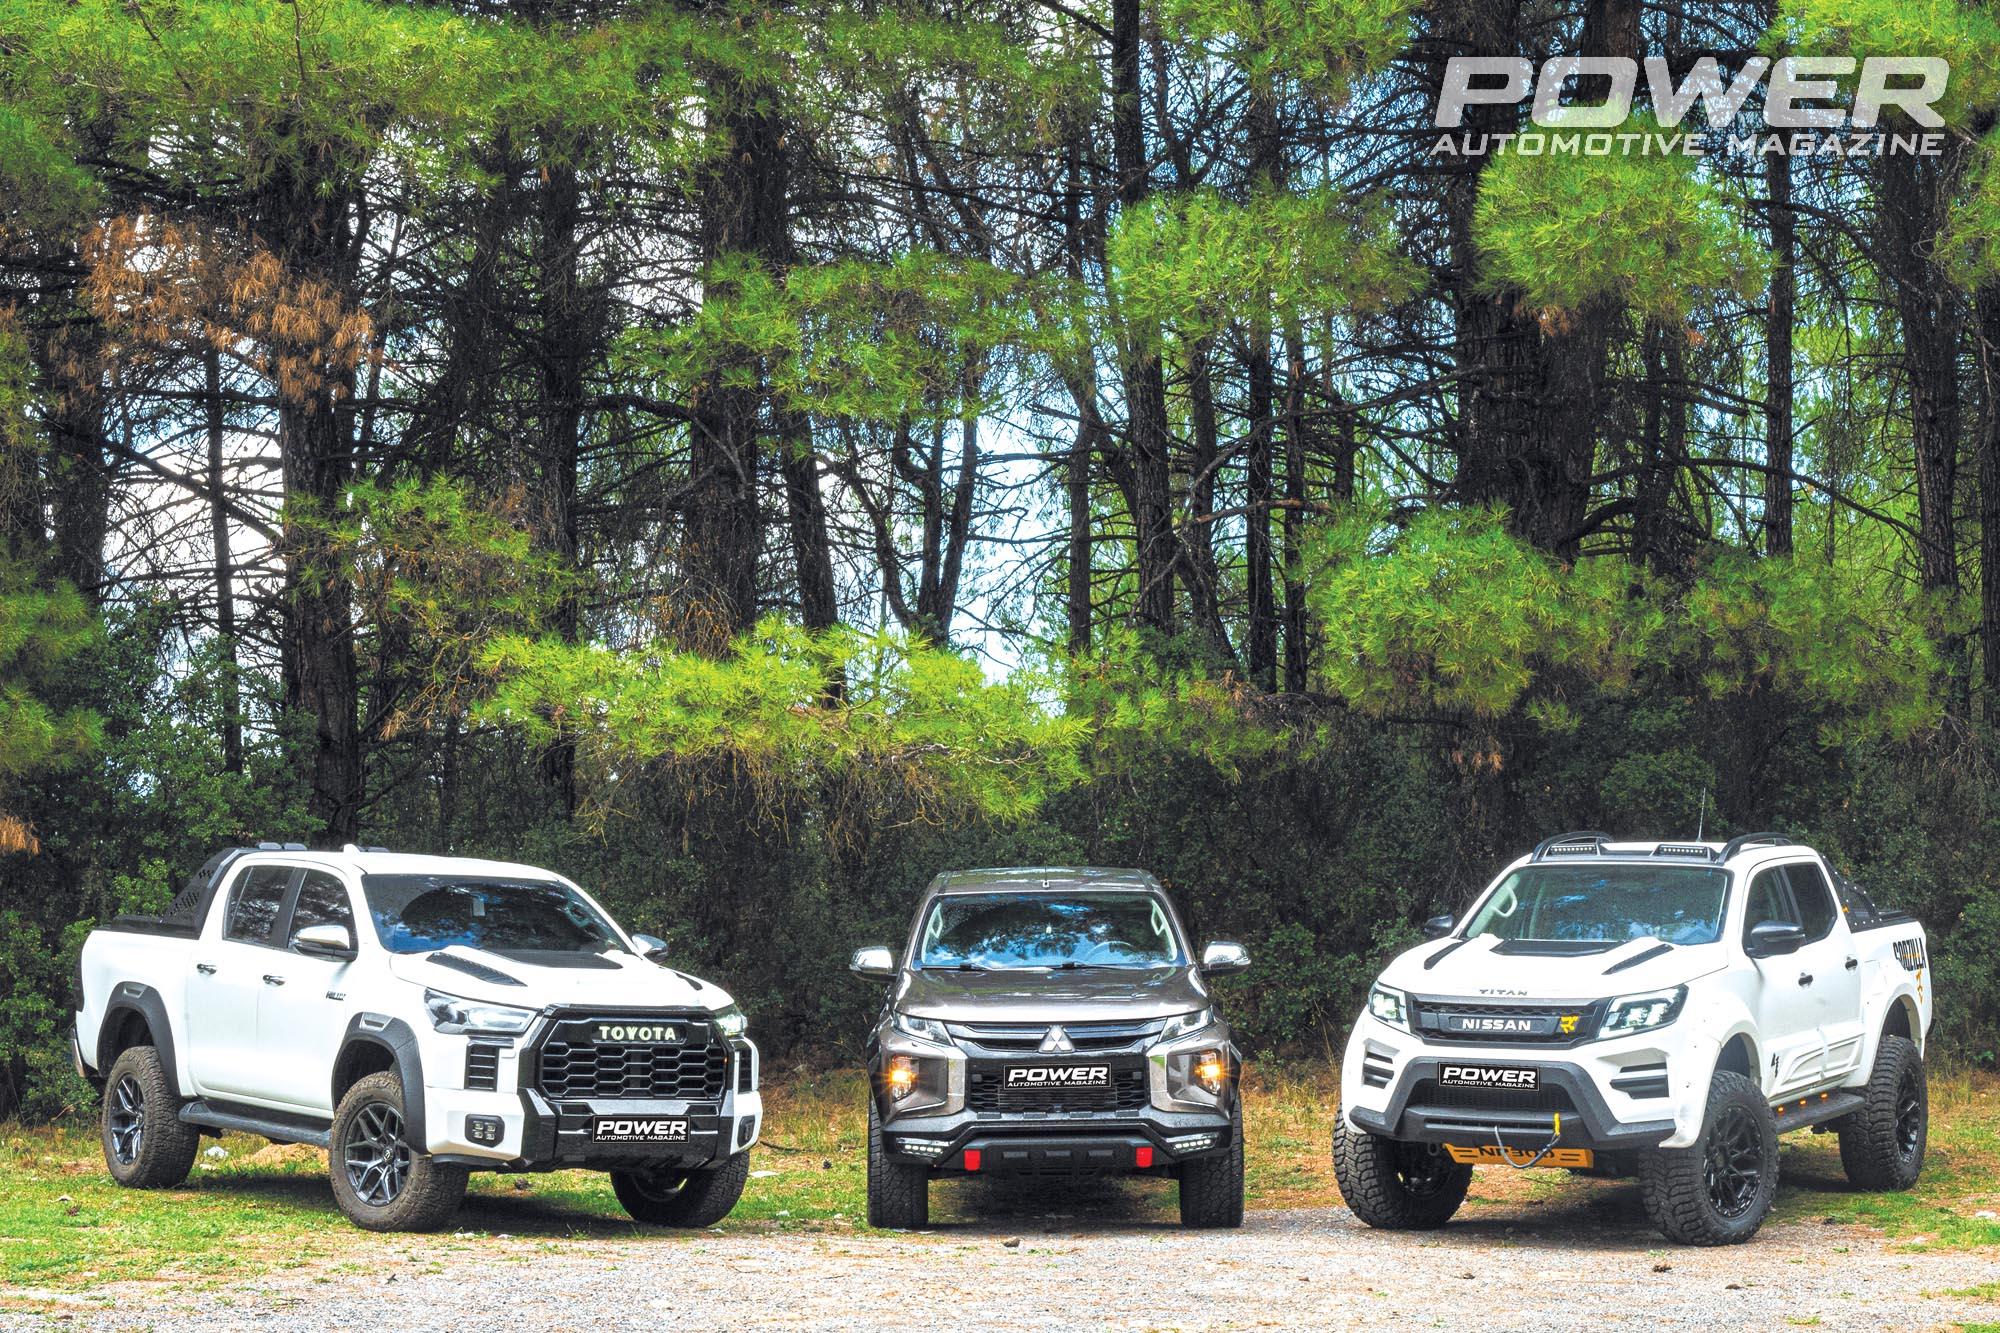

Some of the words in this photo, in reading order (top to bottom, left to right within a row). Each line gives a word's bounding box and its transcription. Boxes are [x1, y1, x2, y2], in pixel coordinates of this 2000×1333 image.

[1462, 1018, 1531, 1031] NISSAN
[599, 1026, 676, 1041] TOYOTA
[1008, 1067, 1108, 1082] POWER
[1443, 1066, 1536, 1083] POWER
[1442, 1079, 1493, 1087] AUTOMOTIVE
[1495, 1081, 1535, 1089] MAGAZINE
[596, 1120, 687, 1135] POWER
